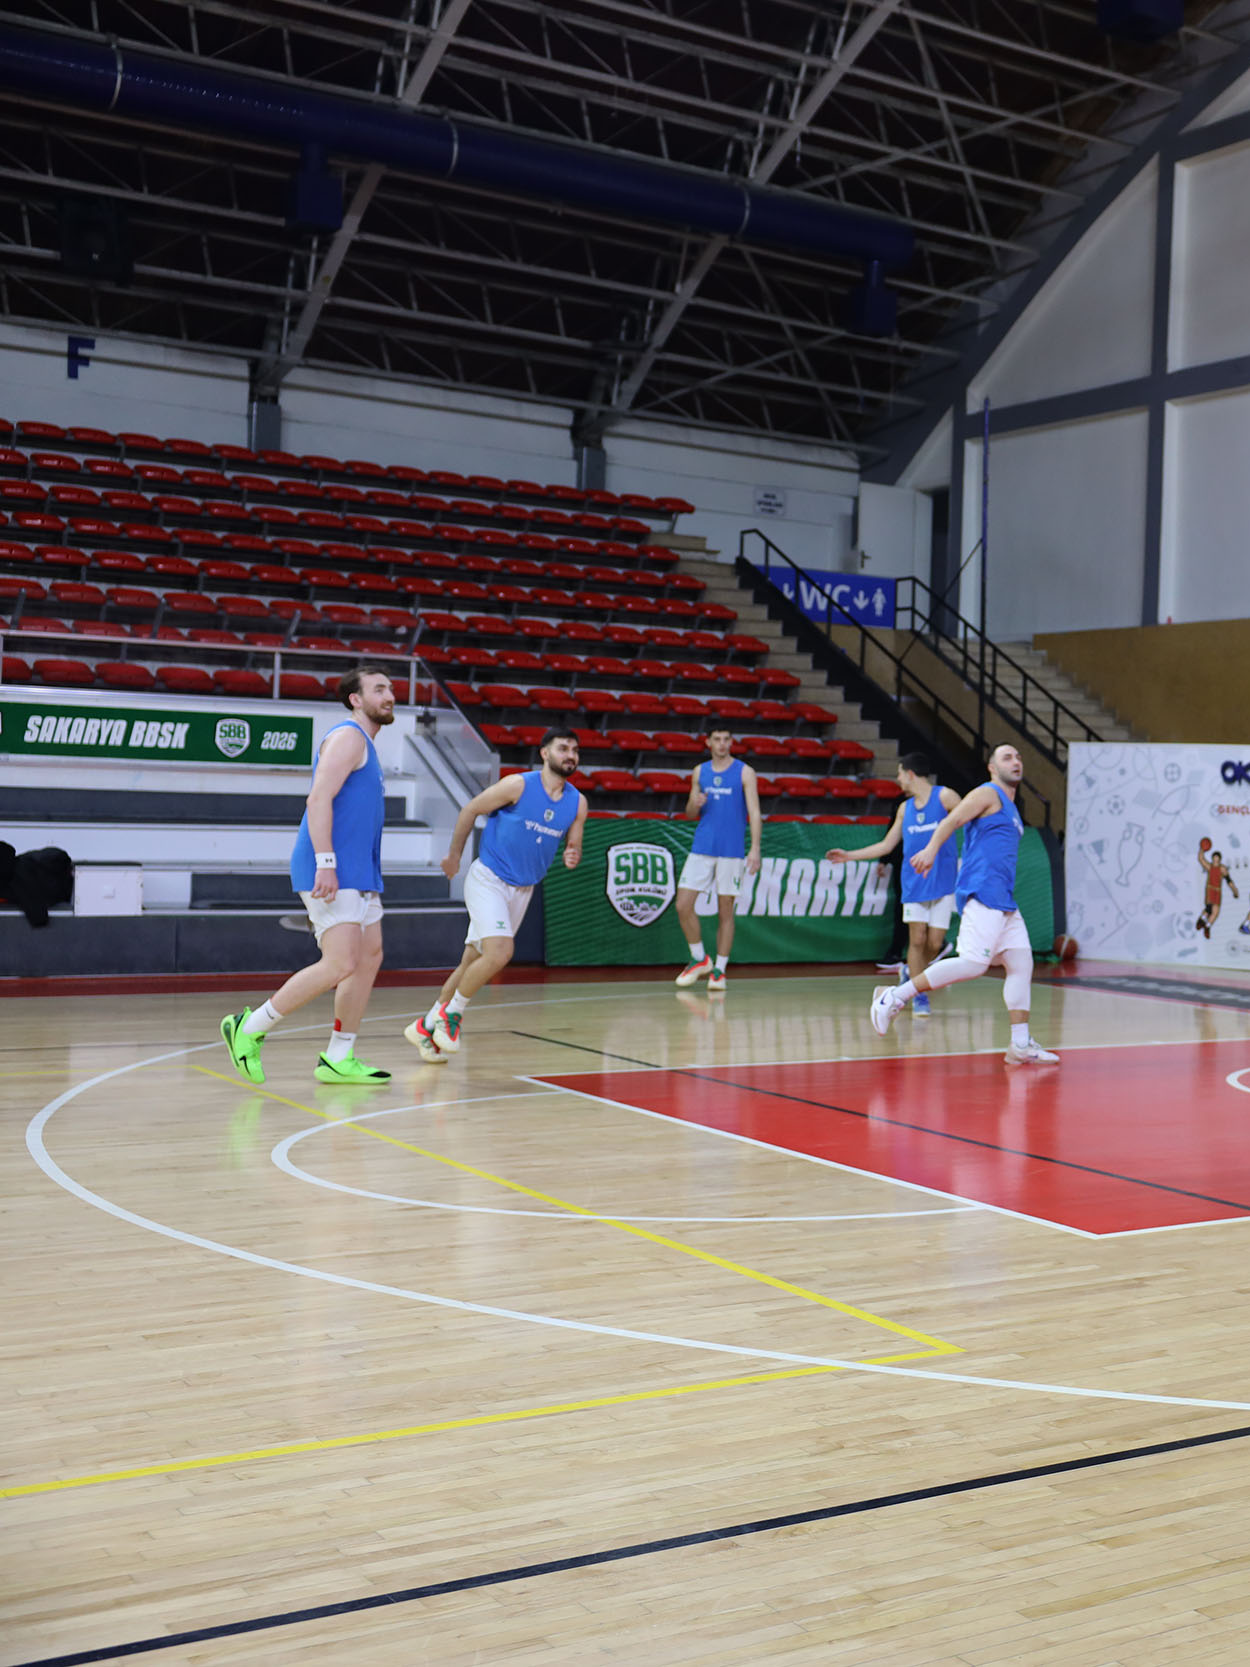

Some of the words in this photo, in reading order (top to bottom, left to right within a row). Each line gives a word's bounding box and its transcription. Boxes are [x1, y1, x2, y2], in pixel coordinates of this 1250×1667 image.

[67, 335, 95, 379] F
[800, 580, 850, 612] WC
[24, 715, 127, 746] SAKARYA
[128, 720, 190, 749] BBSK
[260, 731, 298, 750] 2026
[614, 852, 668, 886] SBB
